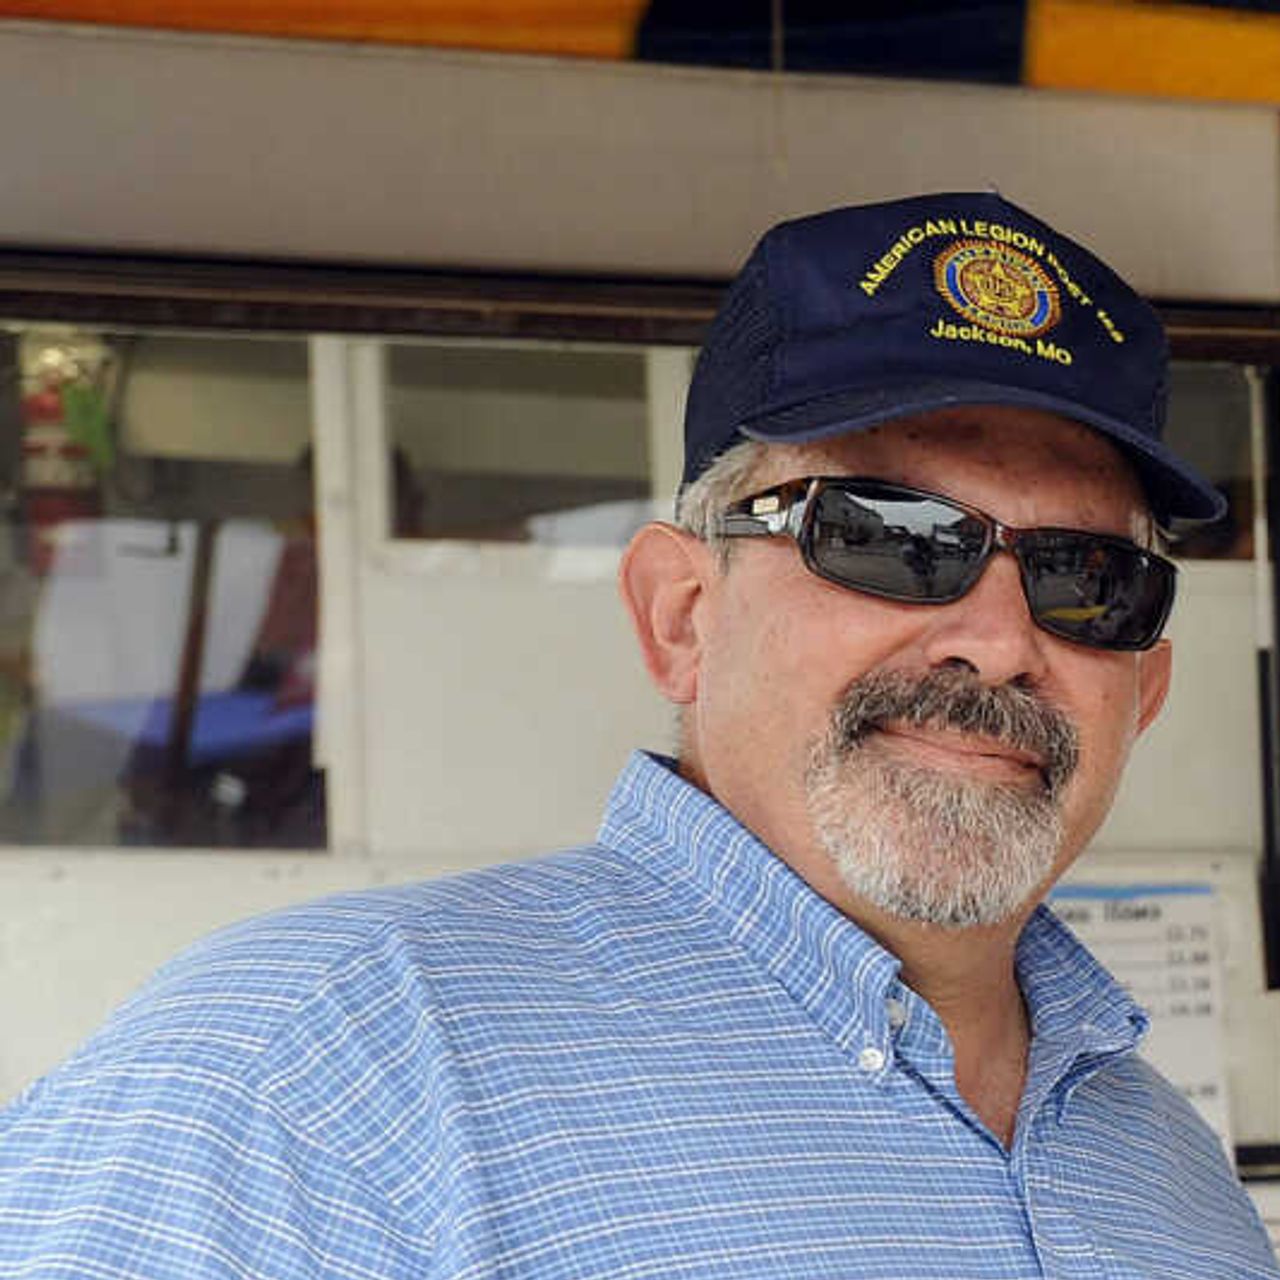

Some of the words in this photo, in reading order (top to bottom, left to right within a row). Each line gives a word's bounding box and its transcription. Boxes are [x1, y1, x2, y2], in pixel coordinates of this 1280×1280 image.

[858, 219, 957, 297] AMERICAN
[960, 221, 1045, 256] LEGION
[930, 319, 1033, 355] Jackson,
[1036, 339, 1073, 365] MO
